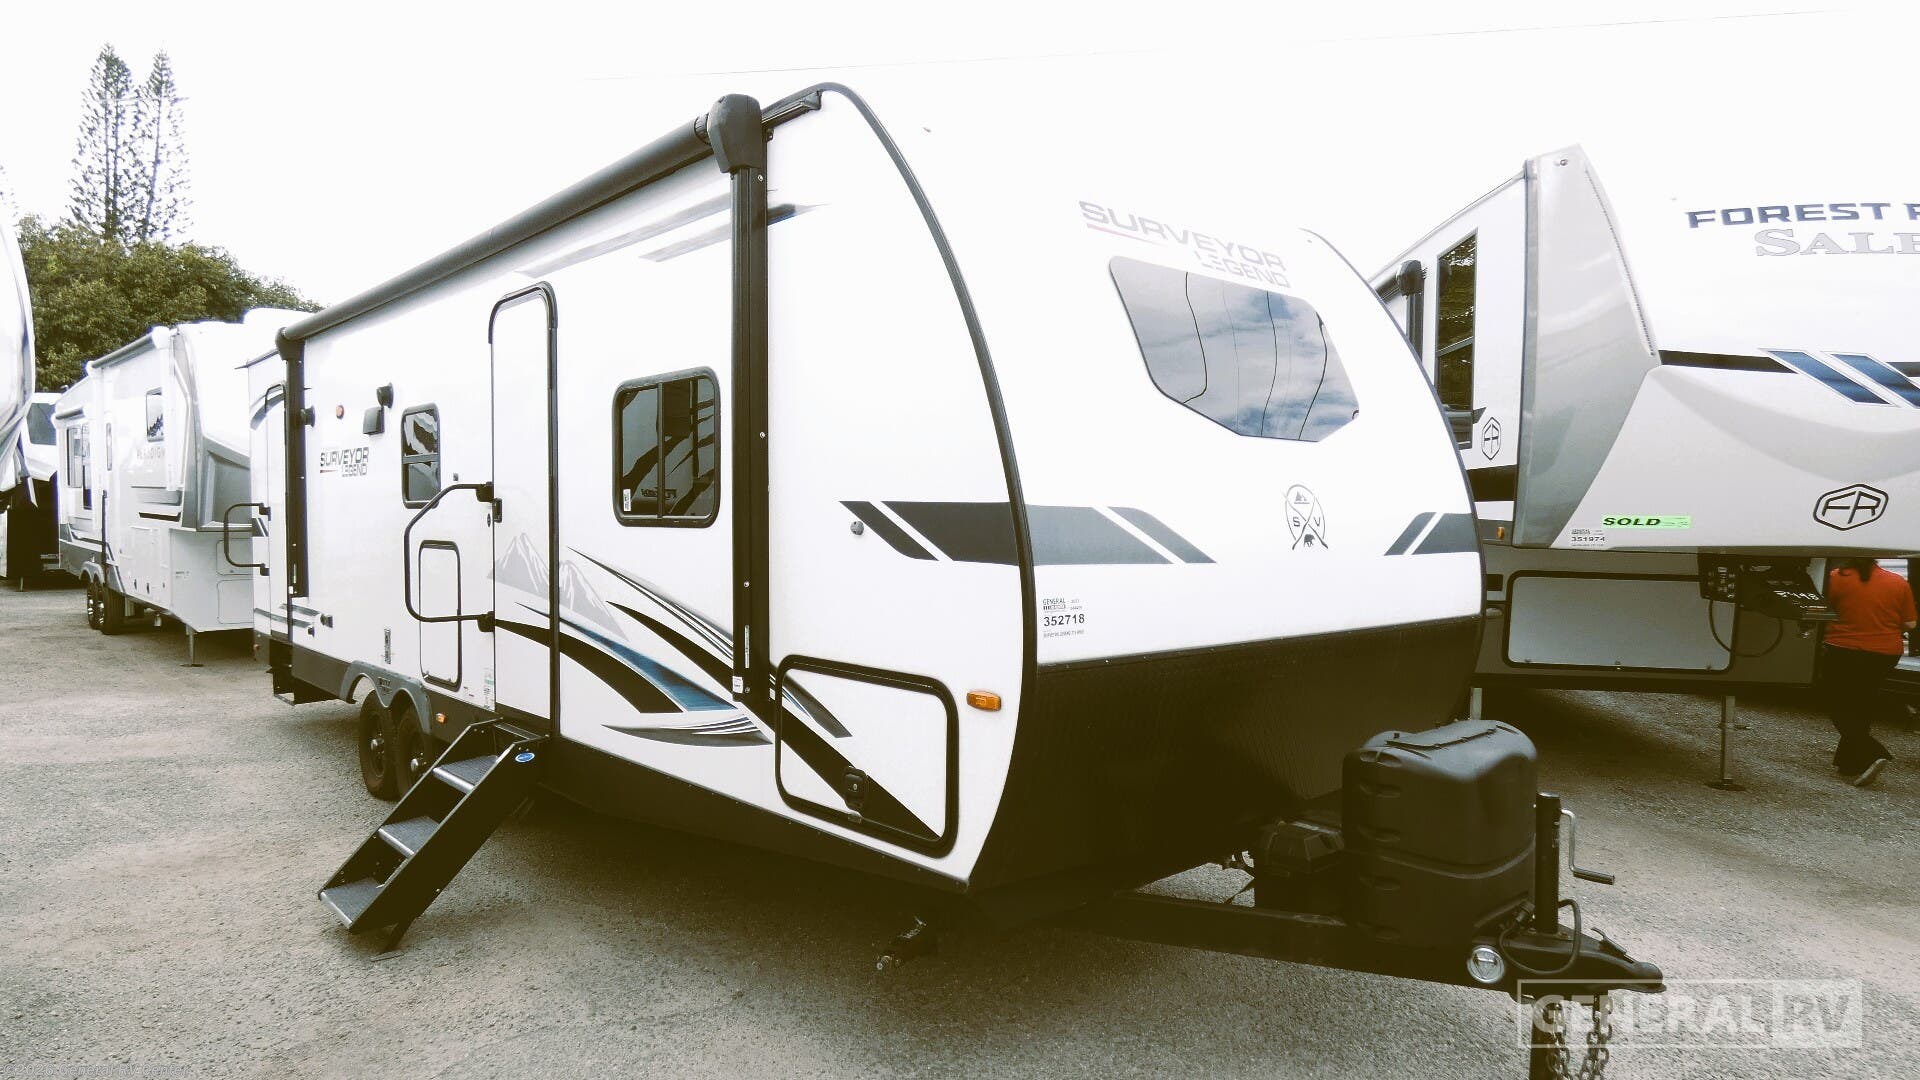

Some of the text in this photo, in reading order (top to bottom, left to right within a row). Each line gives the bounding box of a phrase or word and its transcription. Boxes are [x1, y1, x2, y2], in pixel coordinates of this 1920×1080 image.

[1685, 203, 1891, 228] FOREST
[1078, 200, 1287, 271] SURVEYOR
[1194, 250, 1291, 289] LEGEND
[320, 446, 369, 467] SURVEYOR
[342, 462, 368, 478] LEGEND
[1292, 516, 1321, 527] S V
[1603, 517, 1661, 526] SOLD
[1043, 613, 1085, 627] 352718
